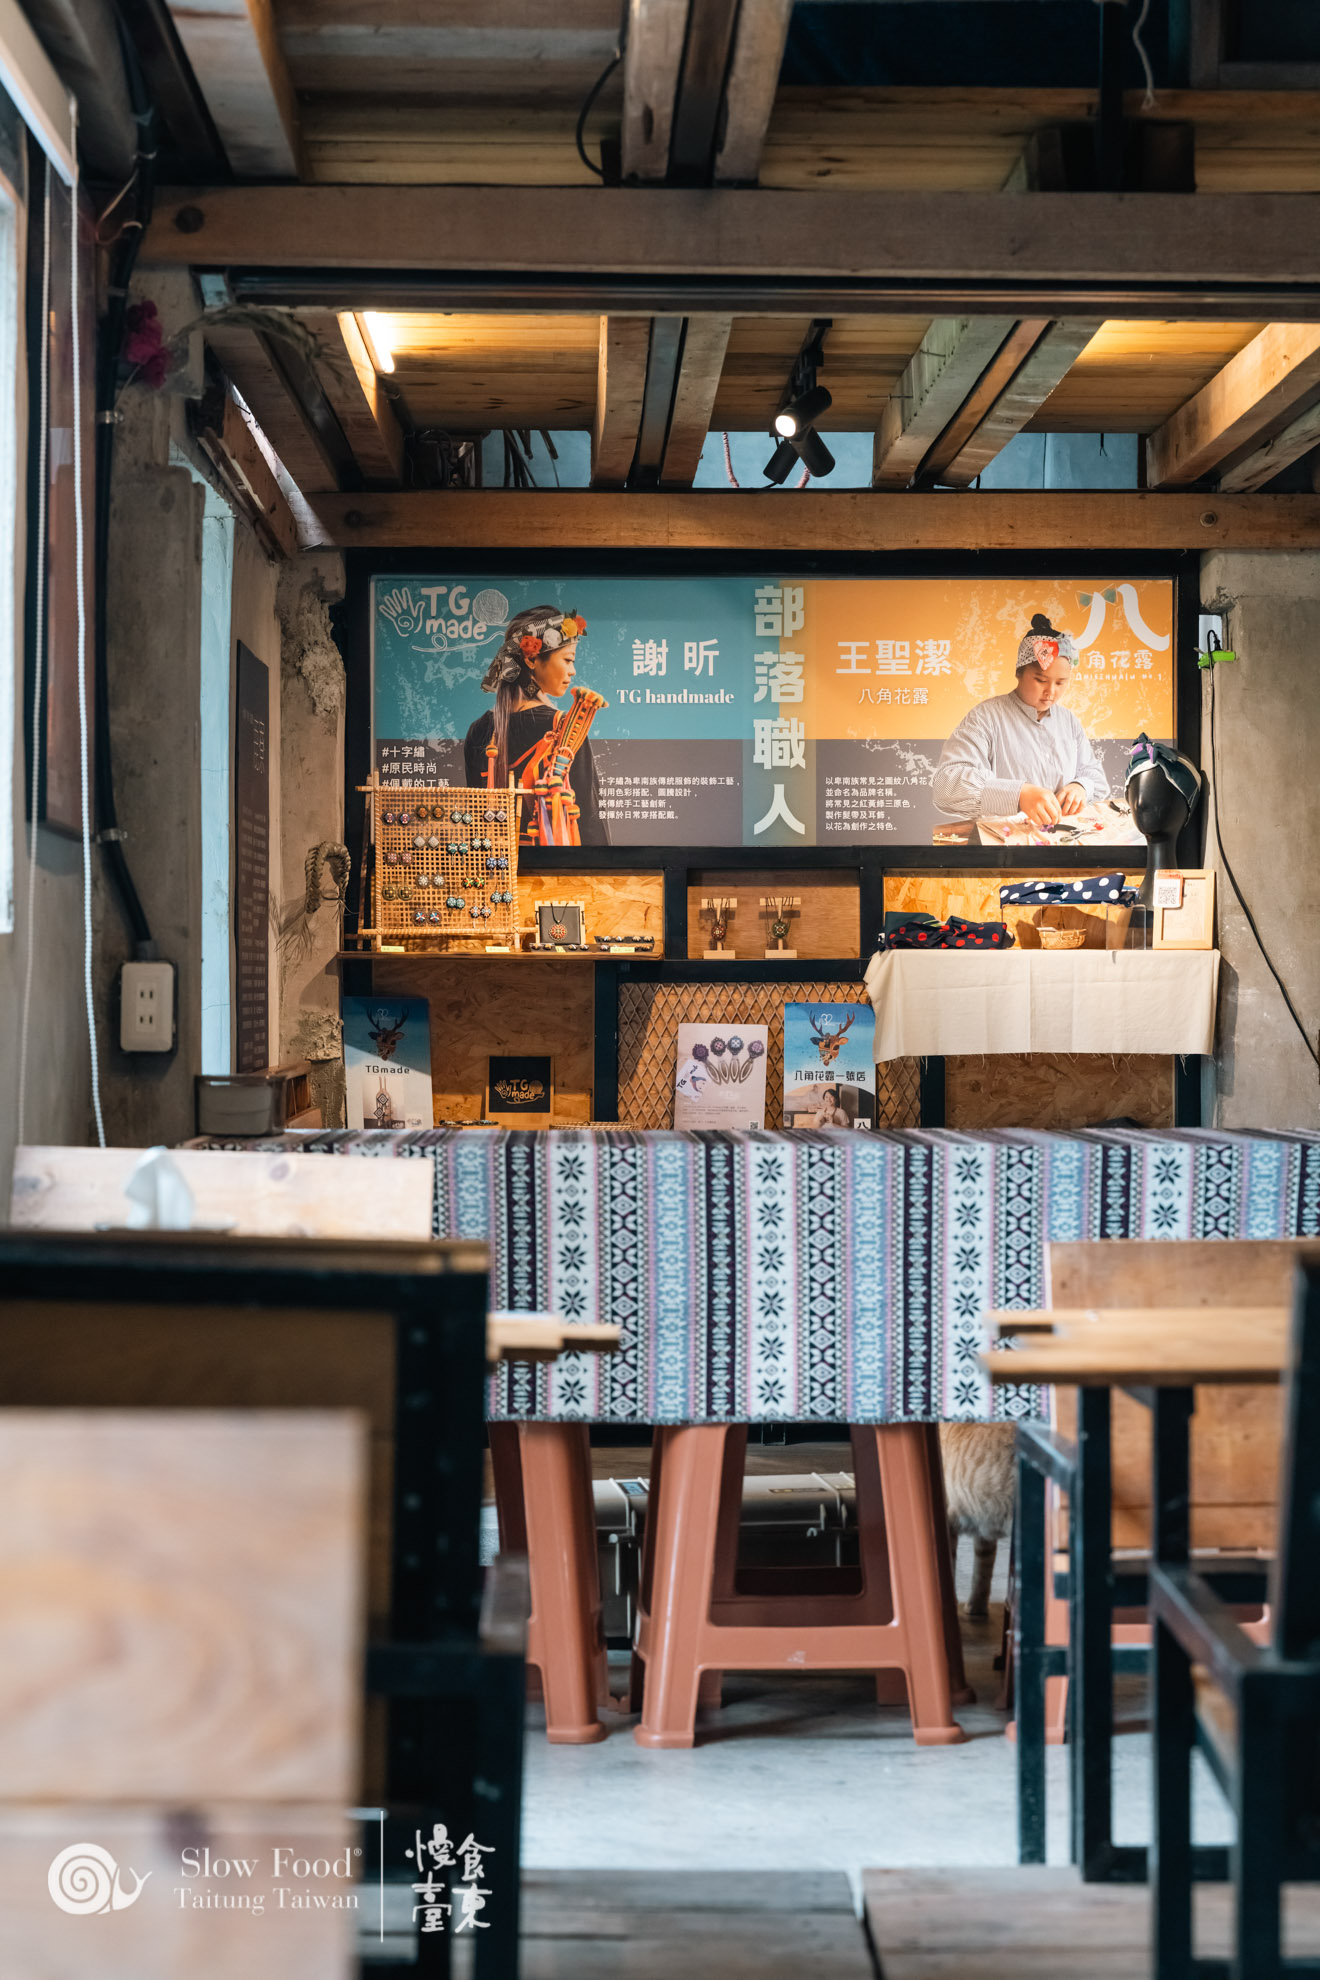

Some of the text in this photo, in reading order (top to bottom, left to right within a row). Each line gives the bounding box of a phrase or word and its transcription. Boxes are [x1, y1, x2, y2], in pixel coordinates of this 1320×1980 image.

[421, 586, 470, 616] TG
[426, 615, 487, 640] made
[632, 639, 720, 676] 謝昕
[836, 640, 952, 676] 王聖潔
[617, 689, 735, 704] TG handmade
[858, 687, 929, 705] 八角花露
[753, 585, 806, 835] 部落職人
[382, 762, 437, 774] #原民時尚
[365, 1065, 410, 1074] TGmade
[510, 1079, 528, 1091] TG
[511, 1090, 535, 1099] made
